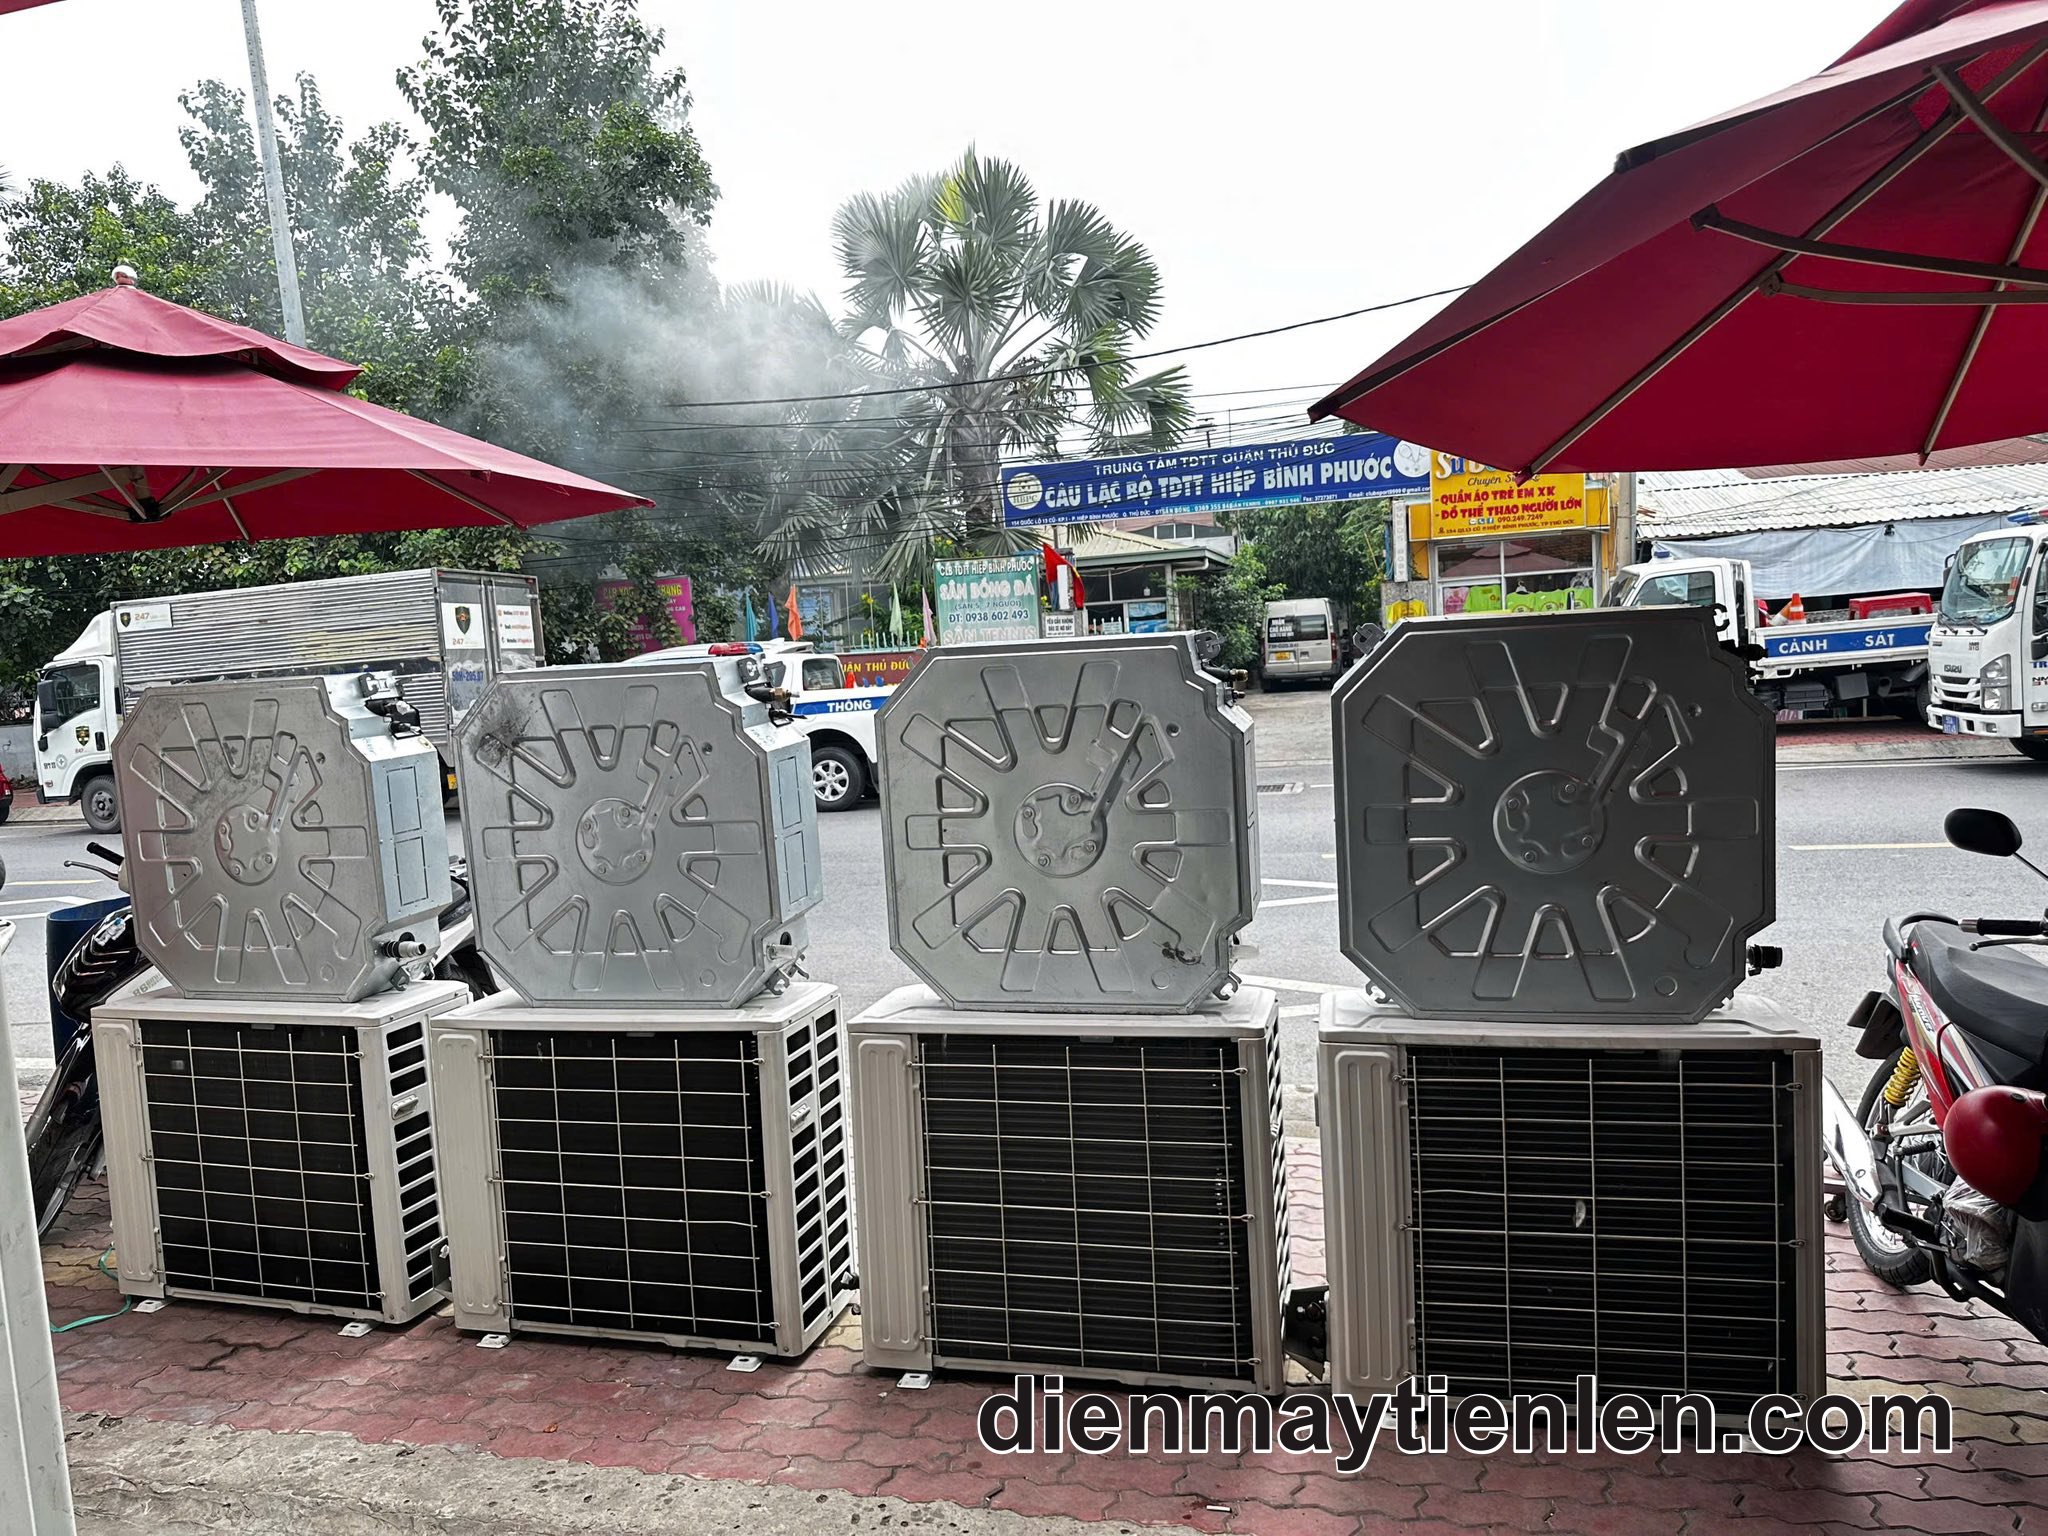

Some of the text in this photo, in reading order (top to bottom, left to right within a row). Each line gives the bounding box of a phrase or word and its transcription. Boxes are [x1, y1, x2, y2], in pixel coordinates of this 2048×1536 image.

[1094, 462, 1143, 476] TRUNG
[1180, 455, 1217, 468] TDTT
[1222, 450, 1264, 464] QUẬN
[1268, 444, 1298, 459] THỦ
[1303, 442, 1335, 455] ĐỨC
[1045, 453, 1392, 508] CÂU LẠC BỘ TDTT HIỆP BÌNH PHƯỚC
[1467, 476, 1501, 487] Chuyên
[1440, 488, 1472, 505] QUẦN
[1474, 488, 1489, 502] ÁO
[1492, 486, 1514, 501] TRẺ
[1517, 487, 1534, 499] EM
[1537, 485, 1556, 497] XK
[1441, 505, 1458, 520] ĐỒ
[1460, 502, 1484, 518] THỂ
[1487, 503, 1518, 517] THAO
[1521, 499, 1559, 514] NGƯỜI
[1560, 496, 1582, 510] LỚN
[940, 566, 953, 576] CLB
[954, 564, 970, 575] TDTT
[940, 573, 1035, 600] SÂN BÓNG ĐÁ
[134, 613, 150, 621] 247
[949, 609, 1029, 623] ĐT: 0938 602 493
[943, 625, 1036, 645] SÂN TENNIS
[1779, 631, 1895, 654] CẢNH SÁT
[865, 659, 887, 672] THỦ
[1944, 664, 1962, 673] ISUZU
[827, 698, 872, 713] THÔNG
